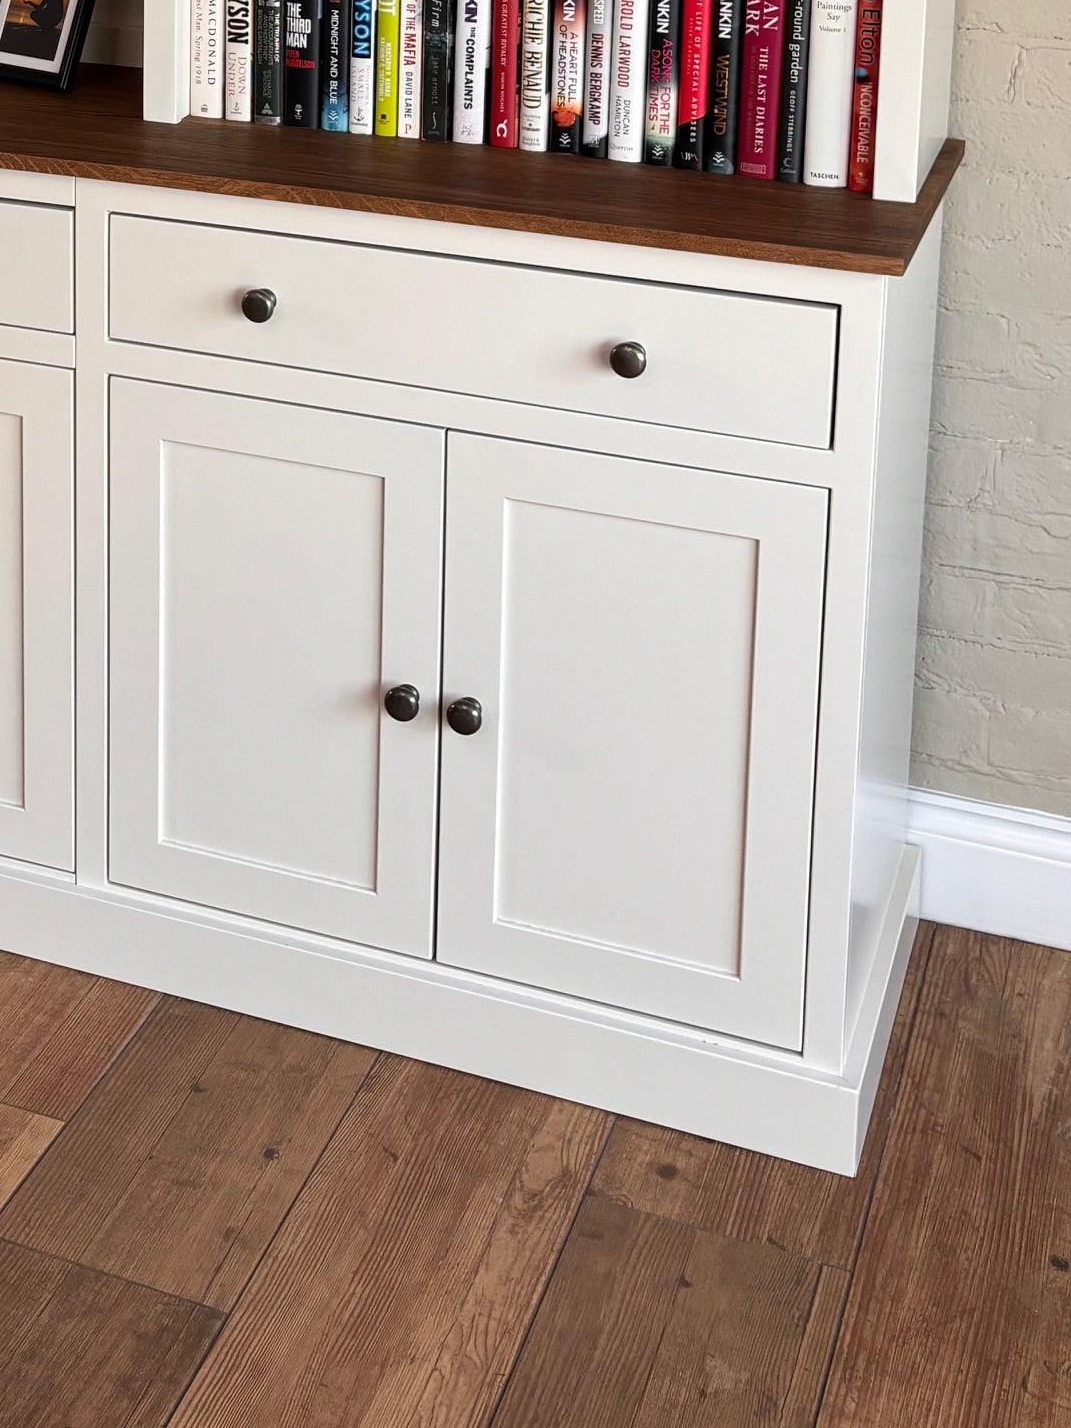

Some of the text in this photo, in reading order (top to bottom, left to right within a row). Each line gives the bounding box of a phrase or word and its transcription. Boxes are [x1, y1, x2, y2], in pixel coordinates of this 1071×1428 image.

[287, 2, 302, 17] THE
[287, 17, 311, 33] THIRD
[286, 32, 307, 48] MAN
[330, 10, 339, 55] MIDNIGHT
[859, 9, 880, 64] Elton
[330, 56, 338, 76] AND
[464, 39, 475, 109] COMPLAINTS
[522, 51, 543, 108] BENAUD
[617, 36, 632, 88] LARWOOD
[788, 44, 802, 83] garden
[329, 80, 338, 104] BLUE
[754, 47, 769, 153] THE LAST DIARIES
